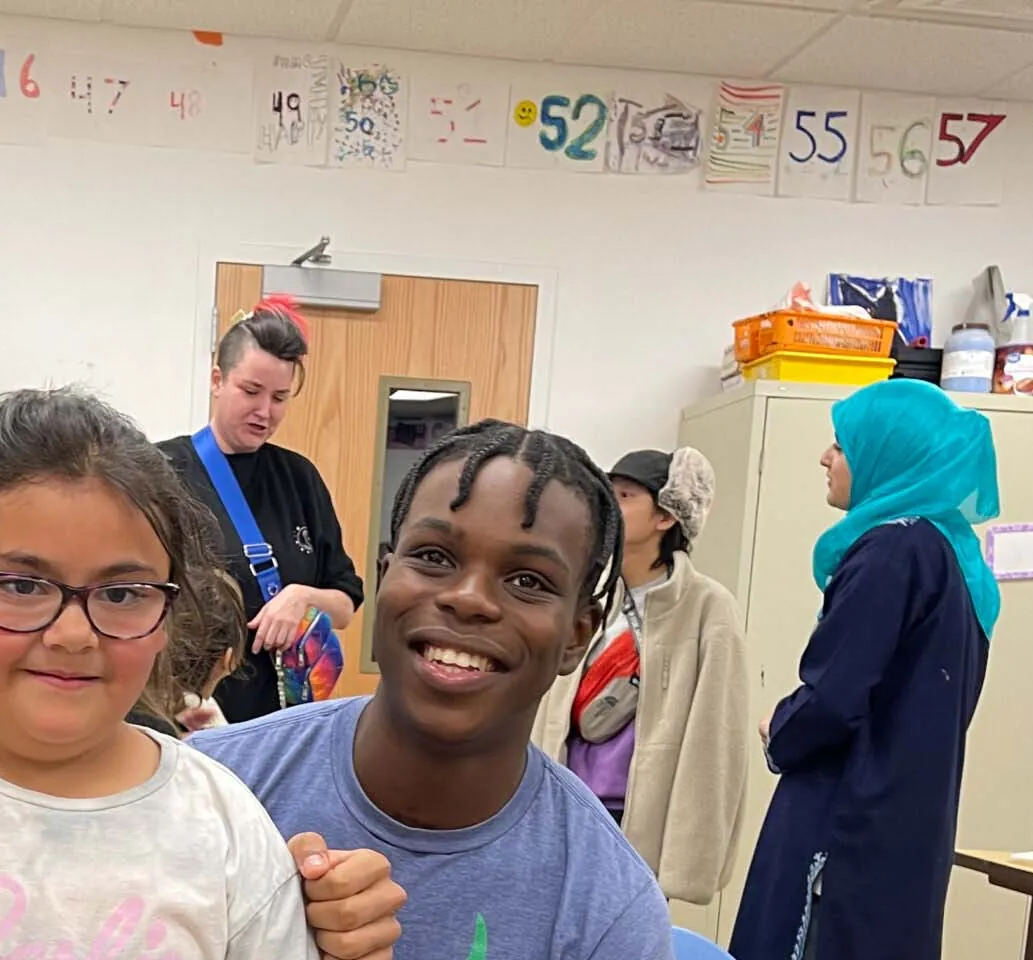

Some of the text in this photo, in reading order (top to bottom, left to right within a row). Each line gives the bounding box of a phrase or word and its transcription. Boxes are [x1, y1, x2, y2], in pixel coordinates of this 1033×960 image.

[71, 75, 130, 114] 47
[272, 91, 302, 127] 49
[539, 94, 607, 160] 52
[788, 110, 848, 164] 55
[935, 112, 1007, 167] 57
